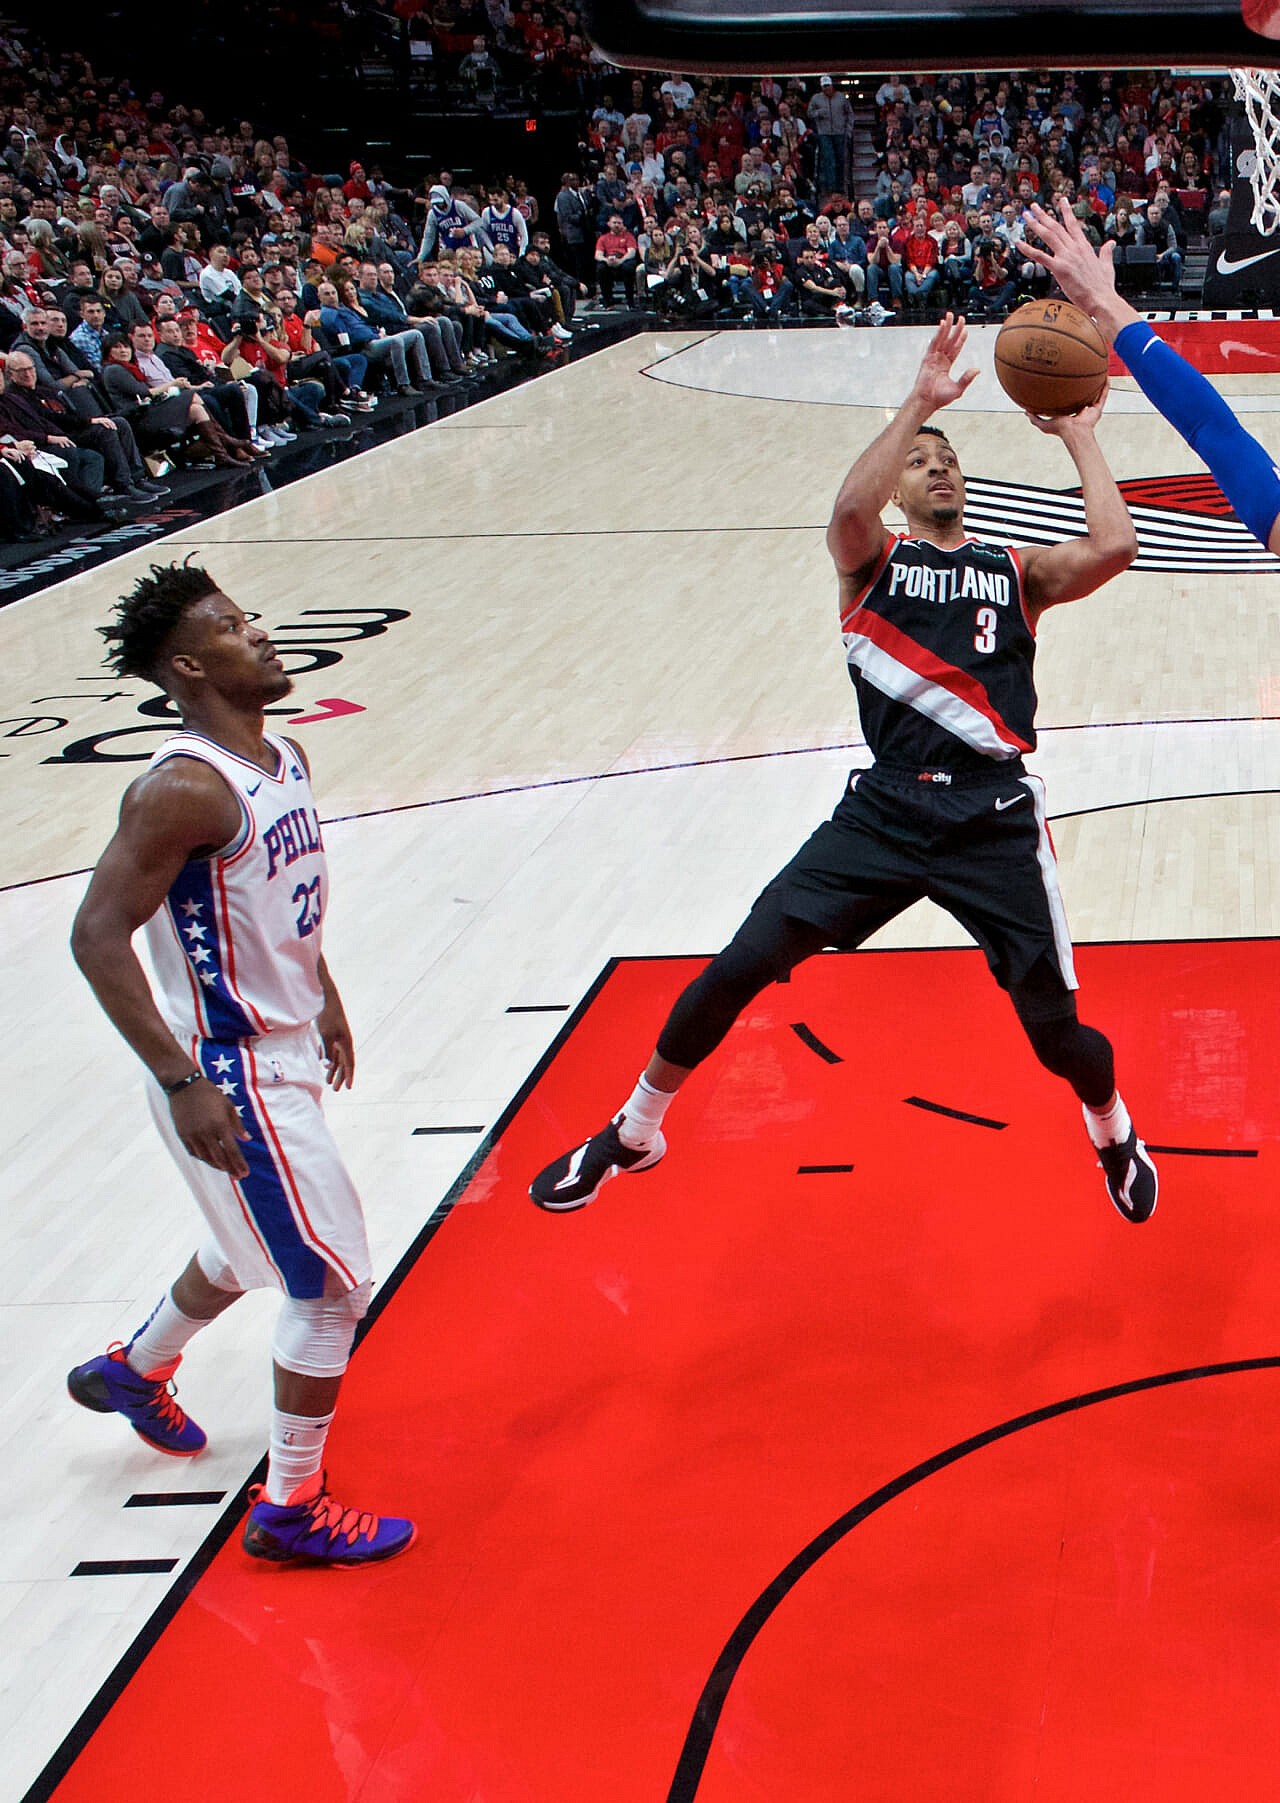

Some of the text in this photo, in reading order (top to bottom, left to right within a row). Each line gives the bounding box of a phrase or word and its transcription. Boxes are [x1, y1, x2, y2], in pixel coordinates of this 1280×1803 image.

[497, 232, 510, 242] 25
[888, 562, 1010, 607] PORTLAND
[974, 607, 997, 654] 3
[263, 807, 325, 881] PHIL
[292, 875, 321, 938] 23
